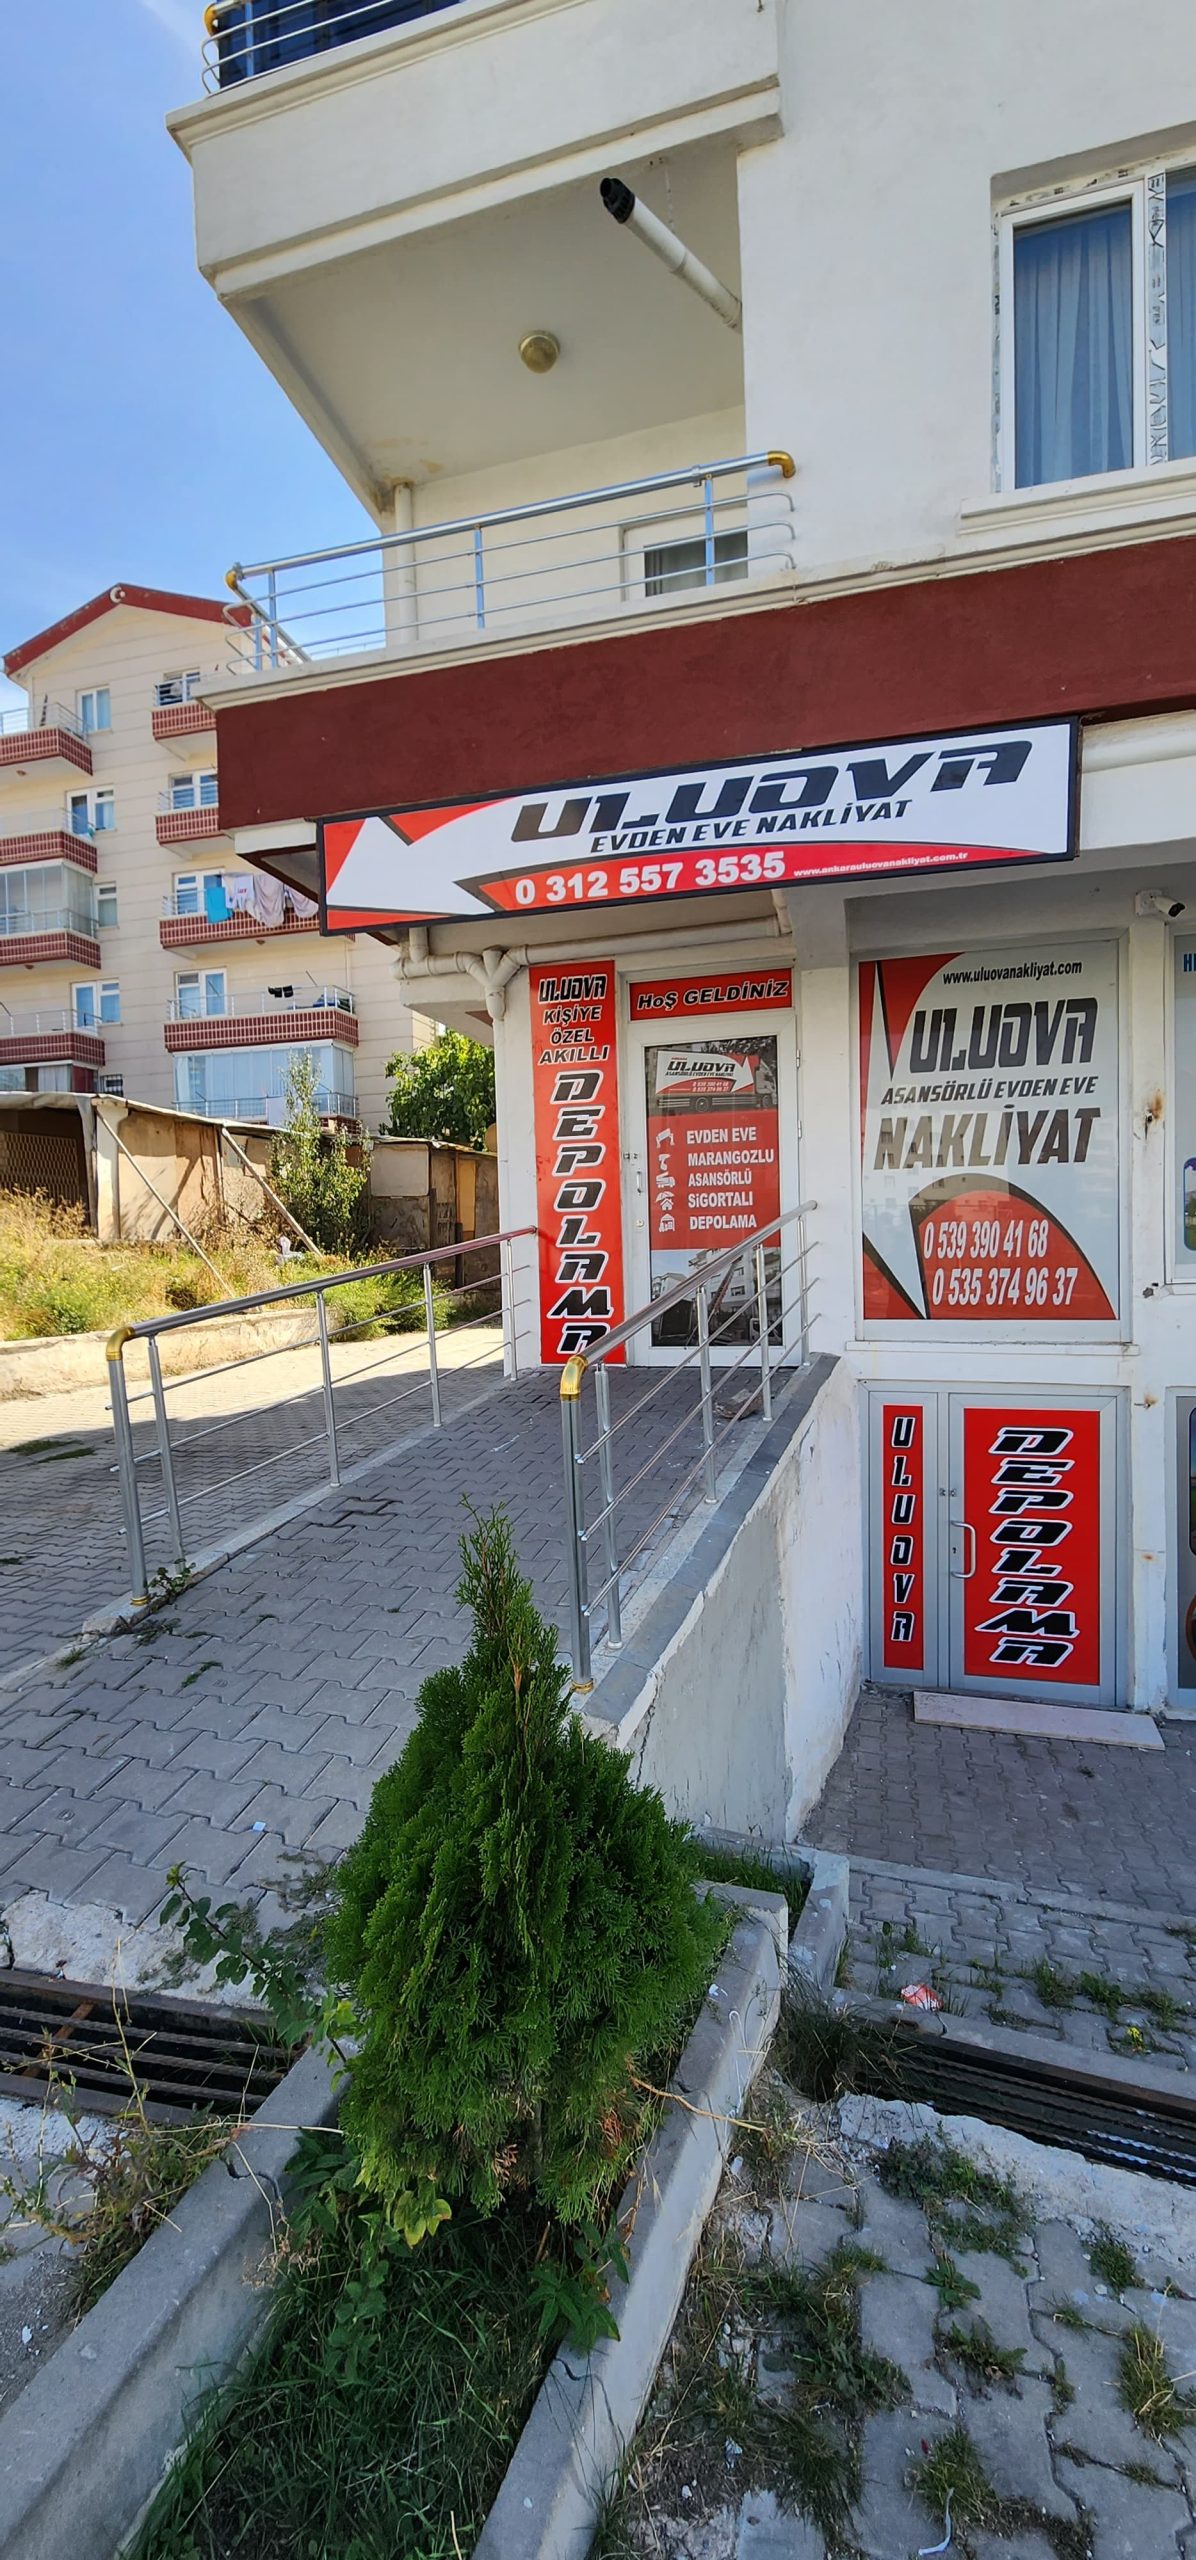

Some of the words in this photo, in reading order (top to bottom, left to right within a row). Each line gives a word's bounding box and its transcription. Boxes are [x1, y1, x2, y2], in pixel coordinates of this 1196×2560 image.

[511, 740, 1032, 843] ULUOVA
[591, 827, 683, 853] EVDEN
[692, 819, 750, 842] EVE
[756, 799, 912, 834] NAKLİYAT
[515, 879, 535, 905] 0
[546, 871, 608, 902] 312
[619, 862, 683, 894] 557
[695, 852, 785, 886] 3535
[793, 852, 968, 877] www.ankarauluovanakliyat.com.tr
[942, 960, 1082, 985] www.uluovanakliyat.com
[538, 974, 607, 1003] ULUOVA
[684, 980, 789, 1005] GELDİNİZ
[543, 1005, 601, 1026] KİŞİYE
[551, 1028, 594, 1045] ÖZEL
[909, 997, 1098, 1074] ULUOVA
[538, 1046, 609, 1065] AKILLI
[881, 1078, 993, 1105] ASANSÖRLÜ
[994, 1078, 1058, 1100] EVDEN
[1059, 1076, 1099, 1095] EVE
[686, 1129, 728, 1144] EVDEN
[732, 1127, 757, 1142] EVE
[874, 1103, 1101, 1170] NAKLİYAT
[688, 1149, 774, 1166] MARANGOZLU
[688, 1168, 752, 1187] ASANSÖRLÜ
[547, 1069, 613, 1355] DEPOLAMA
[689, 1215, 757, 1230] DEPOLAMA
[924, 1221, 934, 1260] 0
[937, 1220, 967, 1260] 539
[970, 1220, 999, 1259] 390
[1003, 1220, 1024, 1258] 41
[1027, 1219, 1049, 1258] 68
[932, 1268, 943, 1306] 0
[948, 1268, 983, 1306] 535
[986, 1268, 1021, 1306] 374
[1025, 1268, 1049, 1306] 96
[1052, 1268, 1078, 1306] 37
[890, 1416, 916, 1642] ULUOVA
[974, 1427, 1080, 1668] DEPOLAMA
